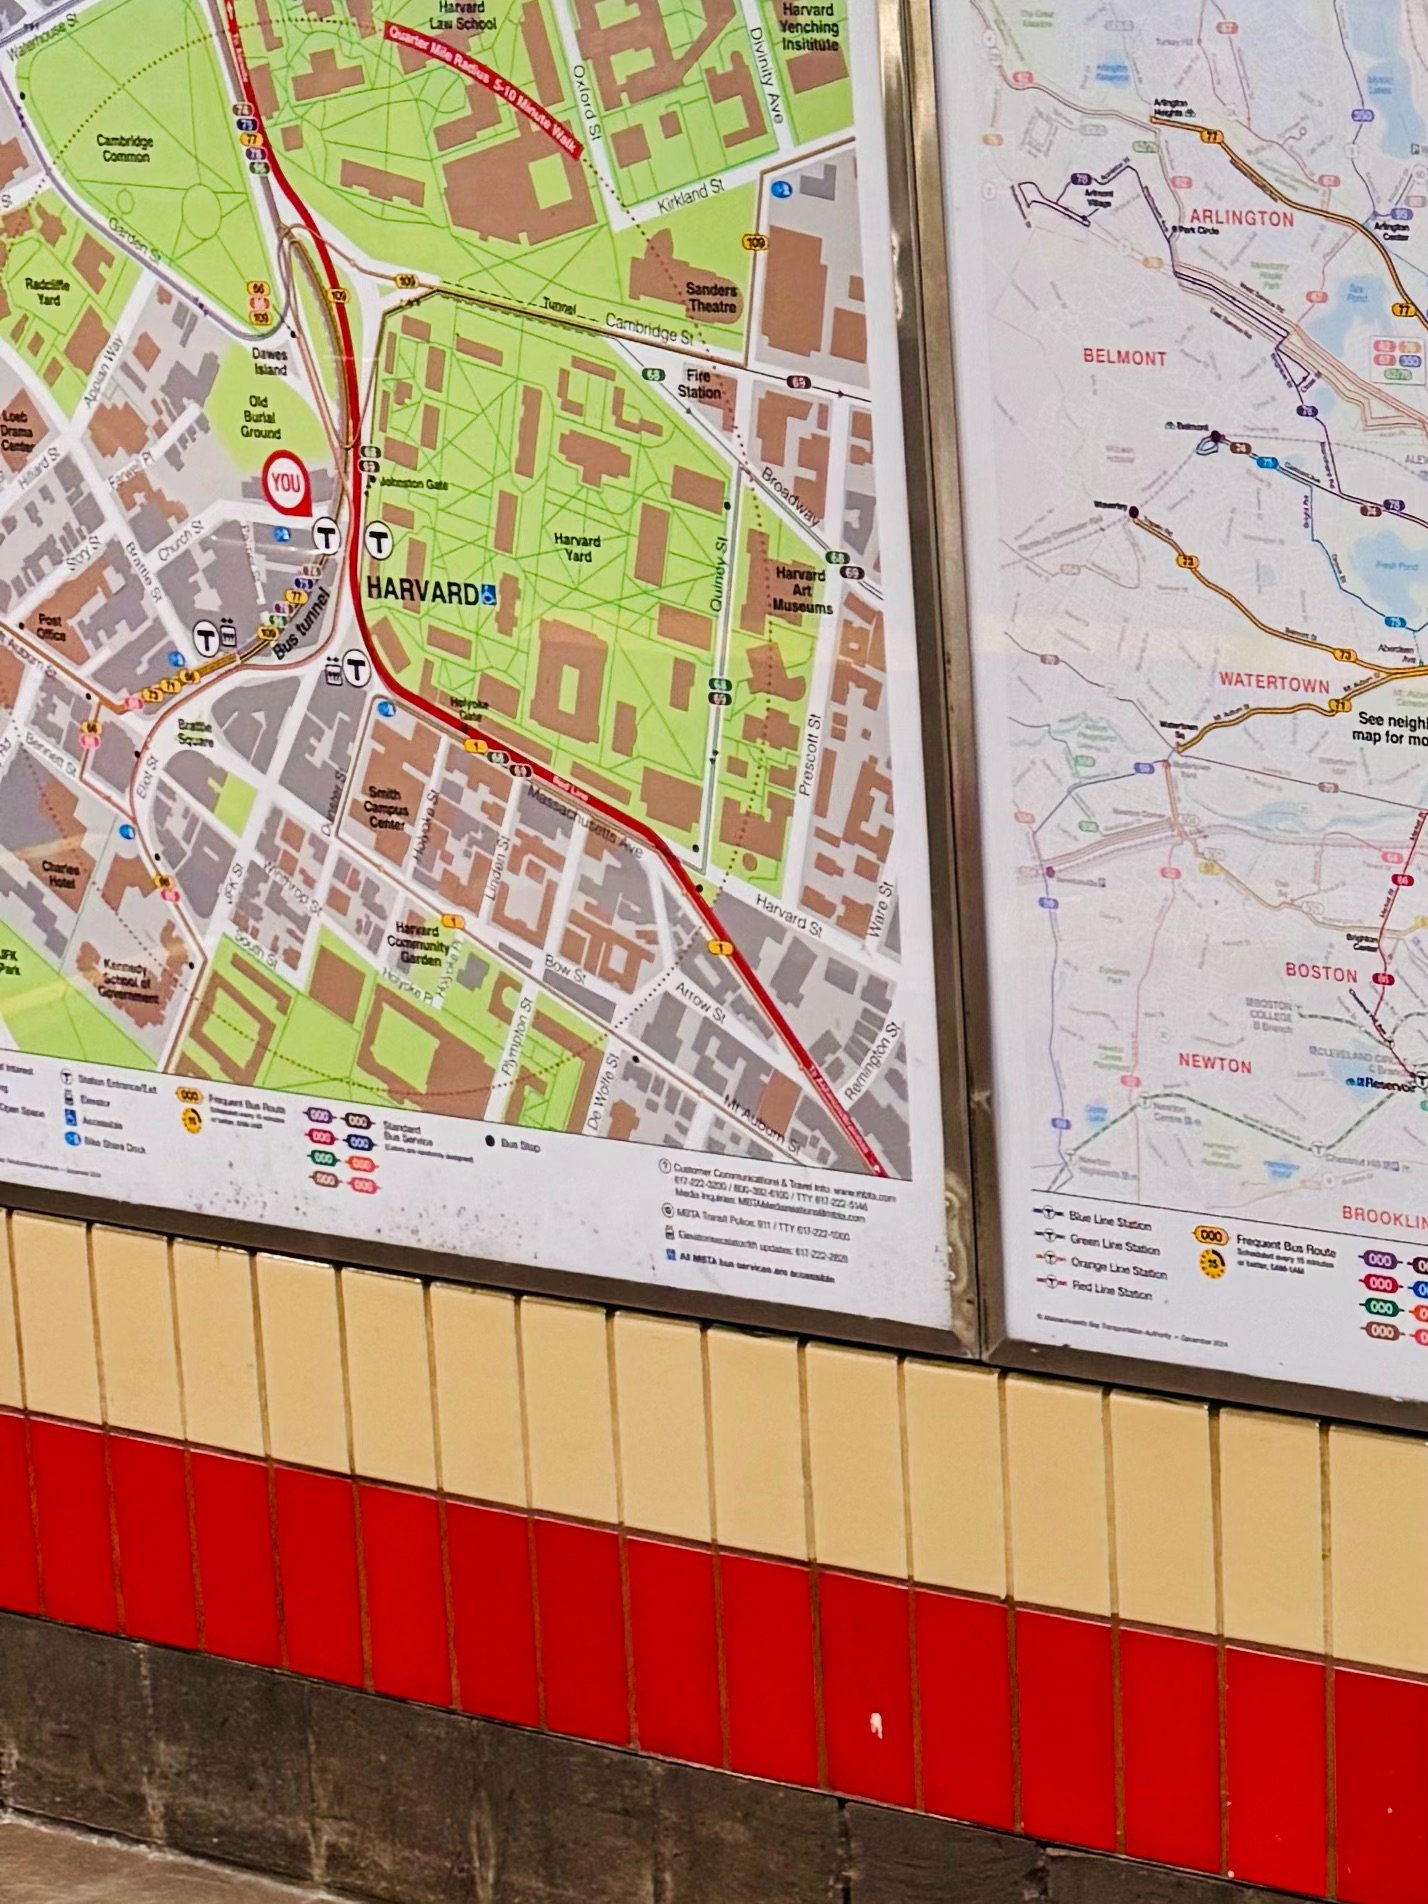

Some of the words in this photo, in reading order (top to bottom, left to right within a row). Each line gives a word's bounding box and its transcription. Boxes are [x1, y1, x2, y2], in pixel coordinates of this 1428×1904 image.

[97, 134, 154, 150] Cambridge
[103, 150, 150, 162] Common
[1189, 208, 1294, 228] ARLINGTON
[686, 282, 738, 297] Sanders
[689, 299, 736, 313] Theatre
[1083, 348, 1165, 366] BELMONT
[271, 472, 300, 494] YOU
[555, 533, 601, 547] Harvard
[564, 548, 592, 562] Yard
[367, 576, 479, 603] HARVARD
[1220, 672, 1329, 694] WATERTOWN
[1359, 711, 1384, 726] See
[1353, 731, 1381, 745] map
[1385, 730, 1404, 744] for
[1284, 962, 1358, 983] BOSTON
[1179, 1054, 1252, 1073] NEWTON
